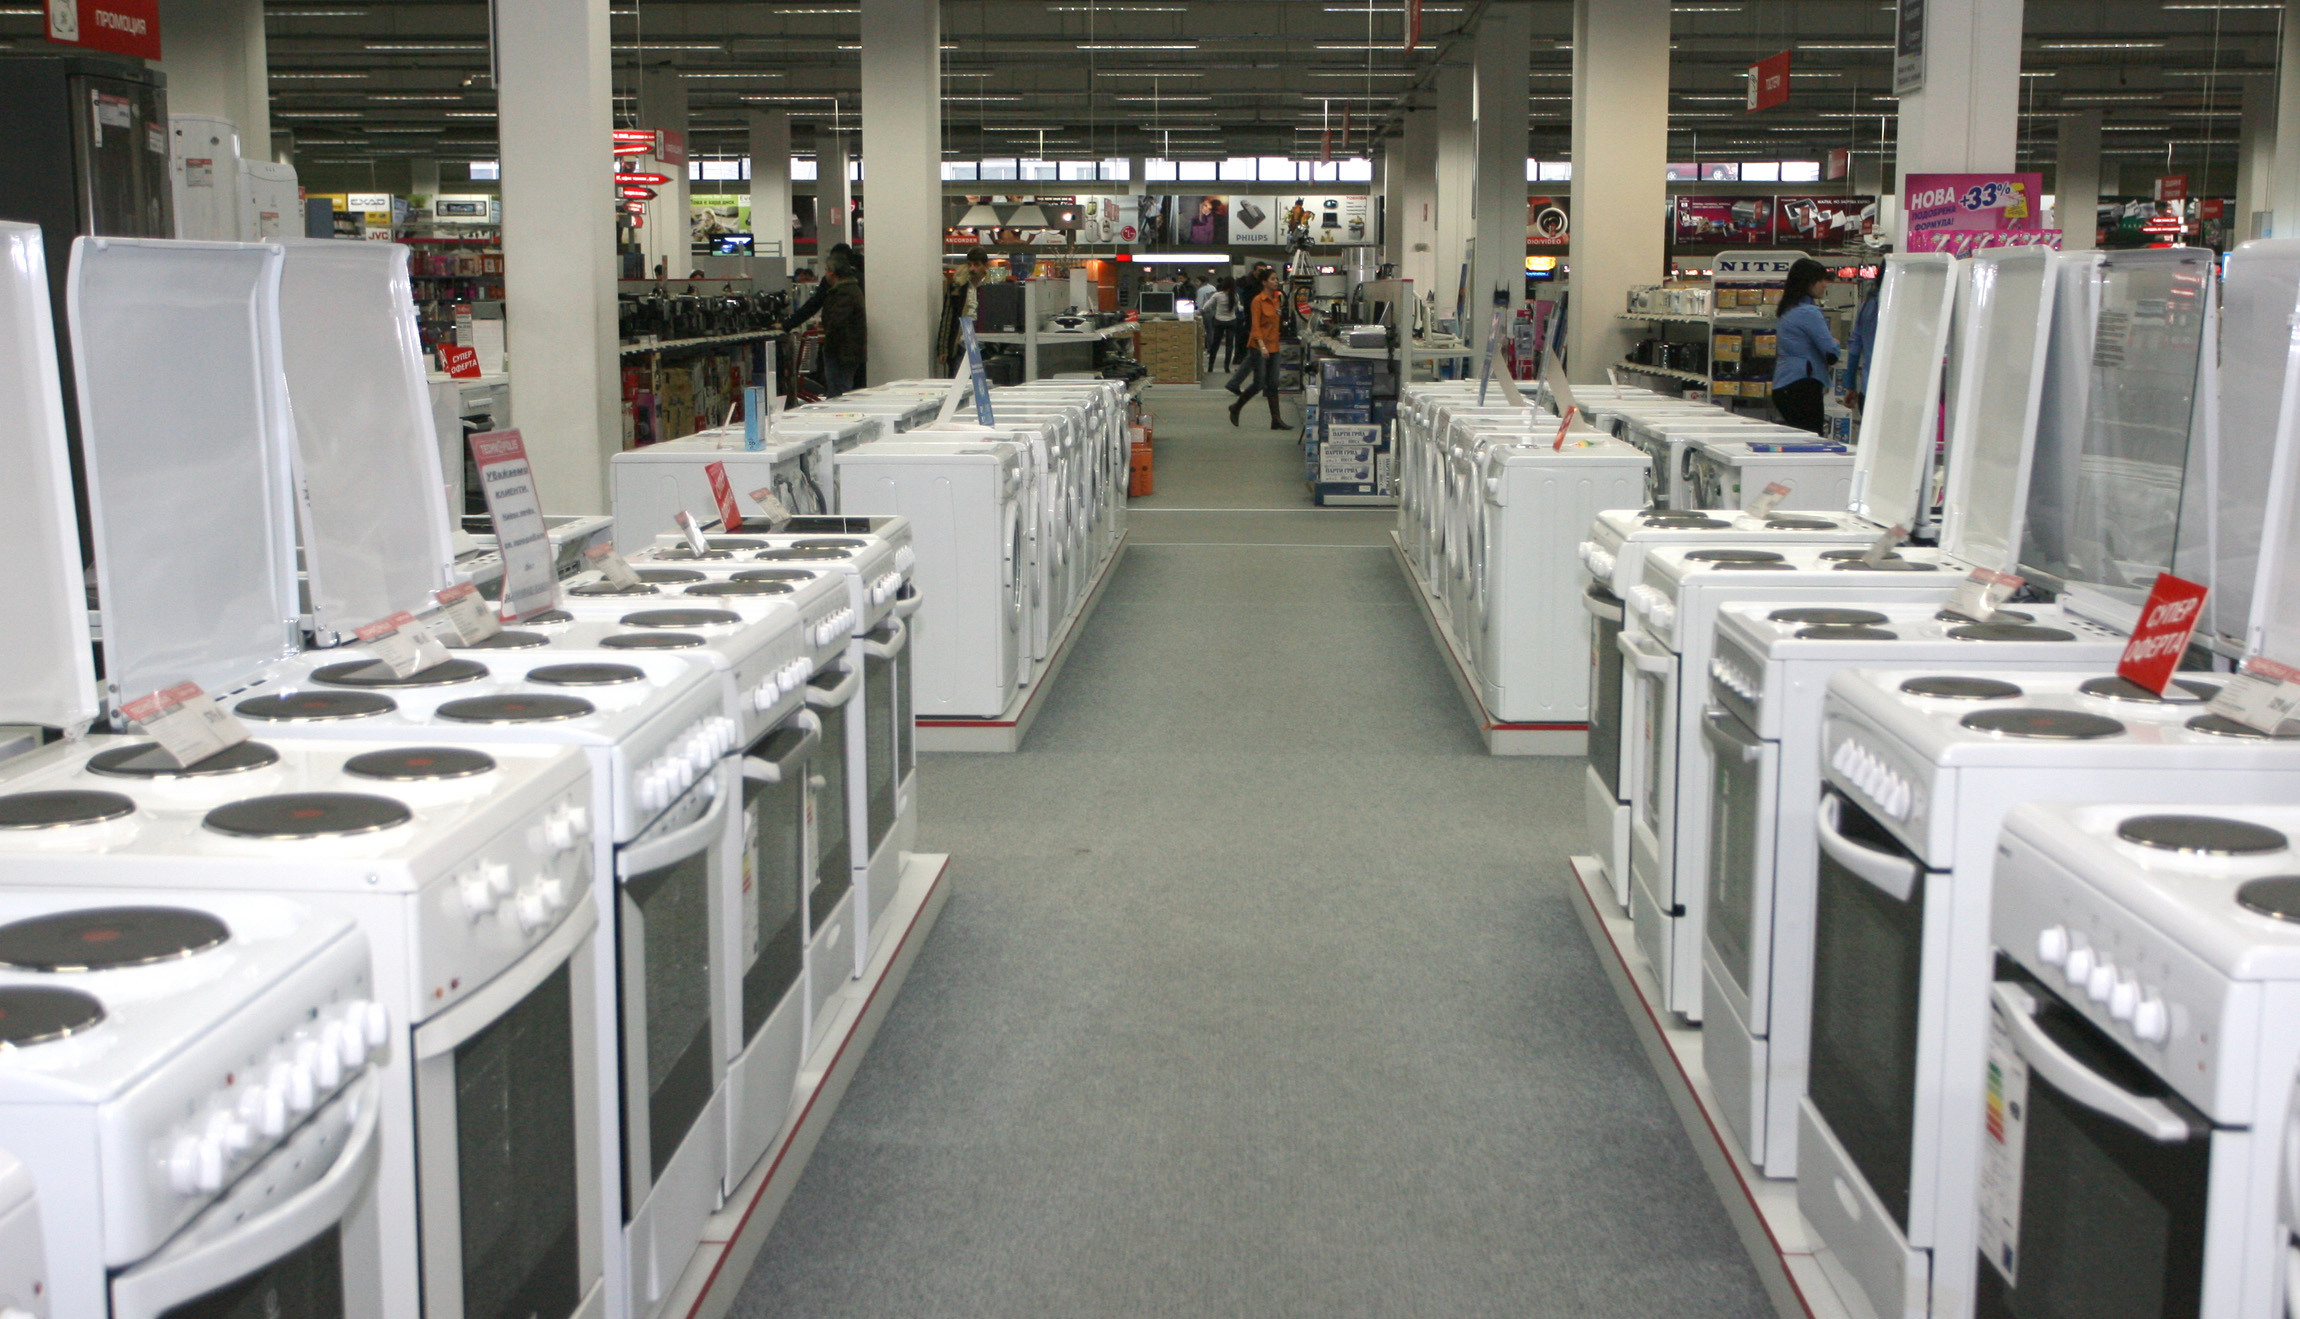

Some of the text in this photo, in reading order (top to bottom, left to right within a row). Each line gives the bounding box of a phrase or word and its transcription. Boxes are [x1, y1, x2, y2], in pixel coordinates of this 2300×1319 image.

[95, 9, 147, 36] ПРОМОЦИЯ
[1911, 182, 2011, 210] НОВА +33%
[1911, 205, 1957, 221] ПОДОБРЕНА
[1914, 217, 1954, 231] ФОРМУЛА!
[368, 231, 390, 241] JVC
[1236, 234, 1269, 242] PHILIPS
[452, 350, 473, 364] СУПЕР
[450, 359, 478, 375] ОФЕРТА
[2145, 597, 2199, 629] СУПЕР
[2122, 630, 2188, 664] ОФЕРТА
